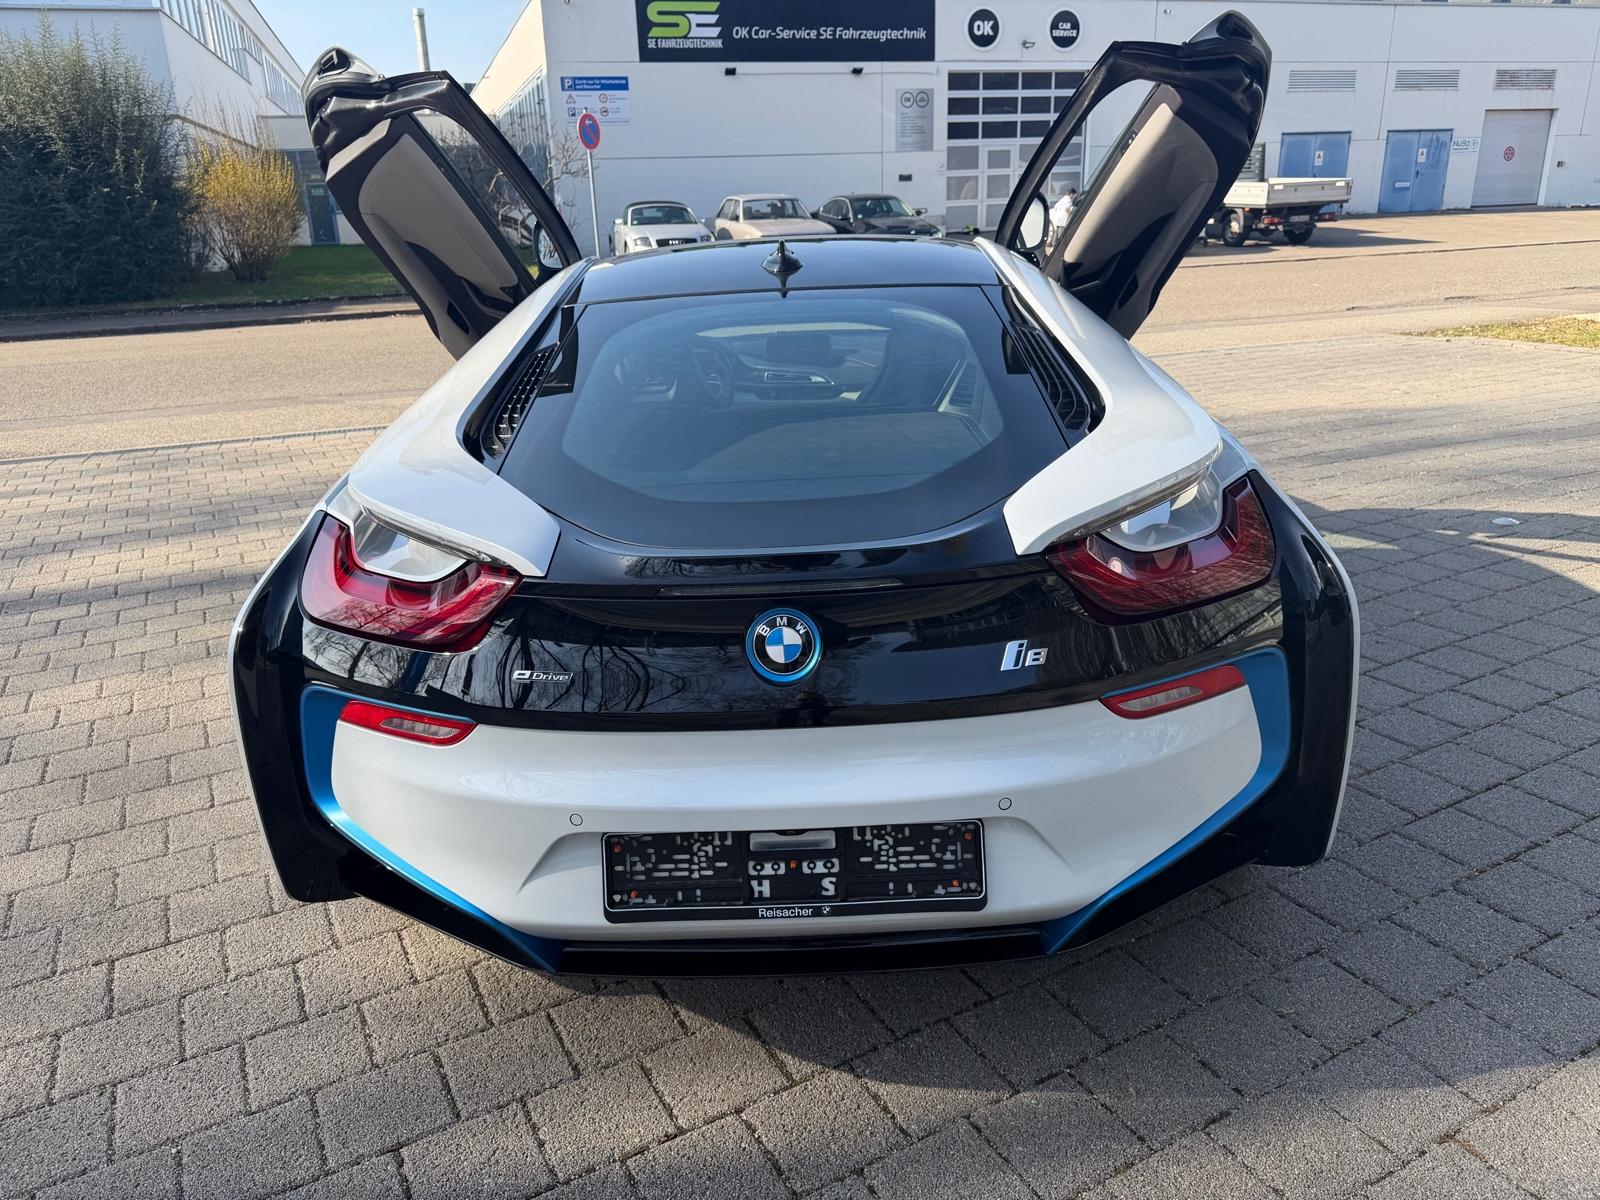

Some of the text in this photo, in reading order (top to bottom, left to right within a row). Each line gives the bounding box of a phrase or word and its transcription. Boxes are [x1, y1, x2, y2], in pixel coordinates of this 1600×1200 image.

[647, 1, 722, 38] SE
[1058, 22, 1071, 30] CAR
[733, 26, 927, 42] OK Car-Service SE Fahrzeugtechnik
[973, 20, 994, 36] OK
[1052, 29, 1077, 37] SERVICE
[647, 38, 723, 48] SE FAHRZEUGTECHNIK
[759, 616, 807, 637] BMW
[1000, 640, 1049, 671] i8
[758, 907, 813, 918] Reisacher
